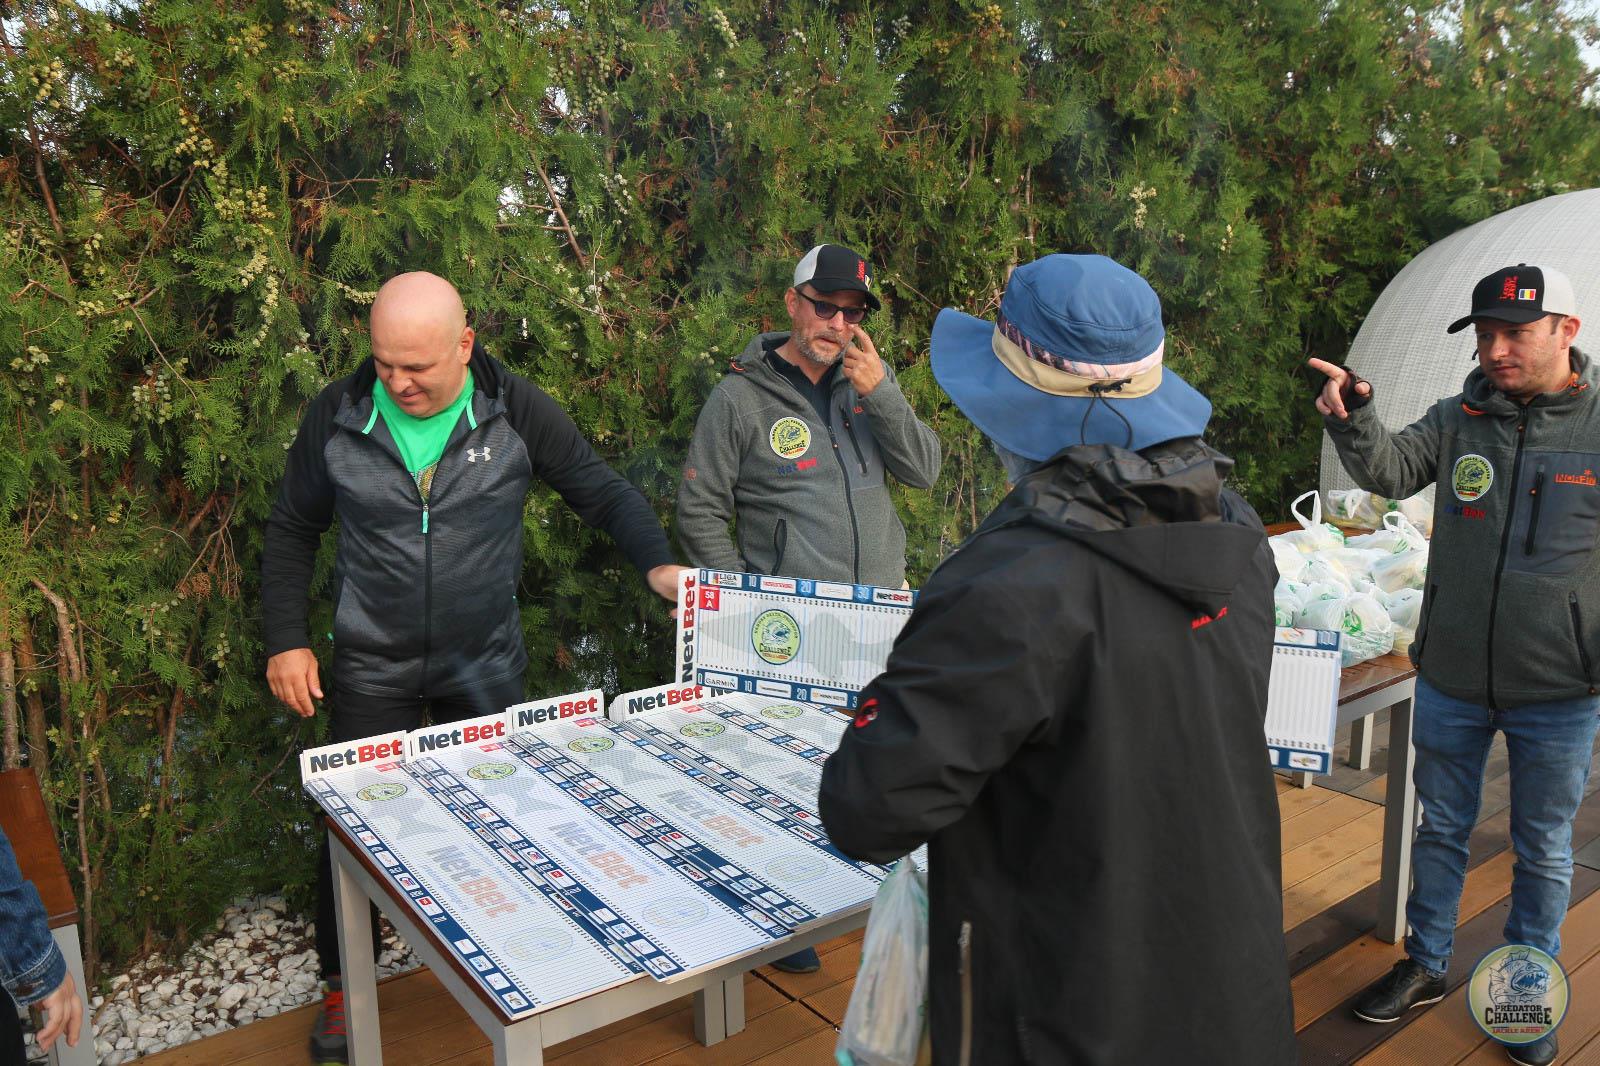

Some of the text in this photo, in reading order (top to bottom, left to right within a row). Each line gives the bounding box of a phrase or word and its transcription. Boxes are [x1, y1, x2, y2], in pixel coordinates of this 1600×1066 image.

[720, 572, 737, 581] LIGA
[800, 580, 812, 593] 20
[876, 592, 910, 602] NetBet
[706, 600, 714, 608] A
[682, 576, 696, 683] NetBet
[705, 678, 736, 688] GARMIN
[628, 684, 704, 714] NetBet
[796, 688, 807, 700] 20
[852, 696, 858, 708] 3
[518, 696, 598, 727] NetBet
[419, 720, 505, 753] NetBet
[310, 739, 402, 774] NetBet
